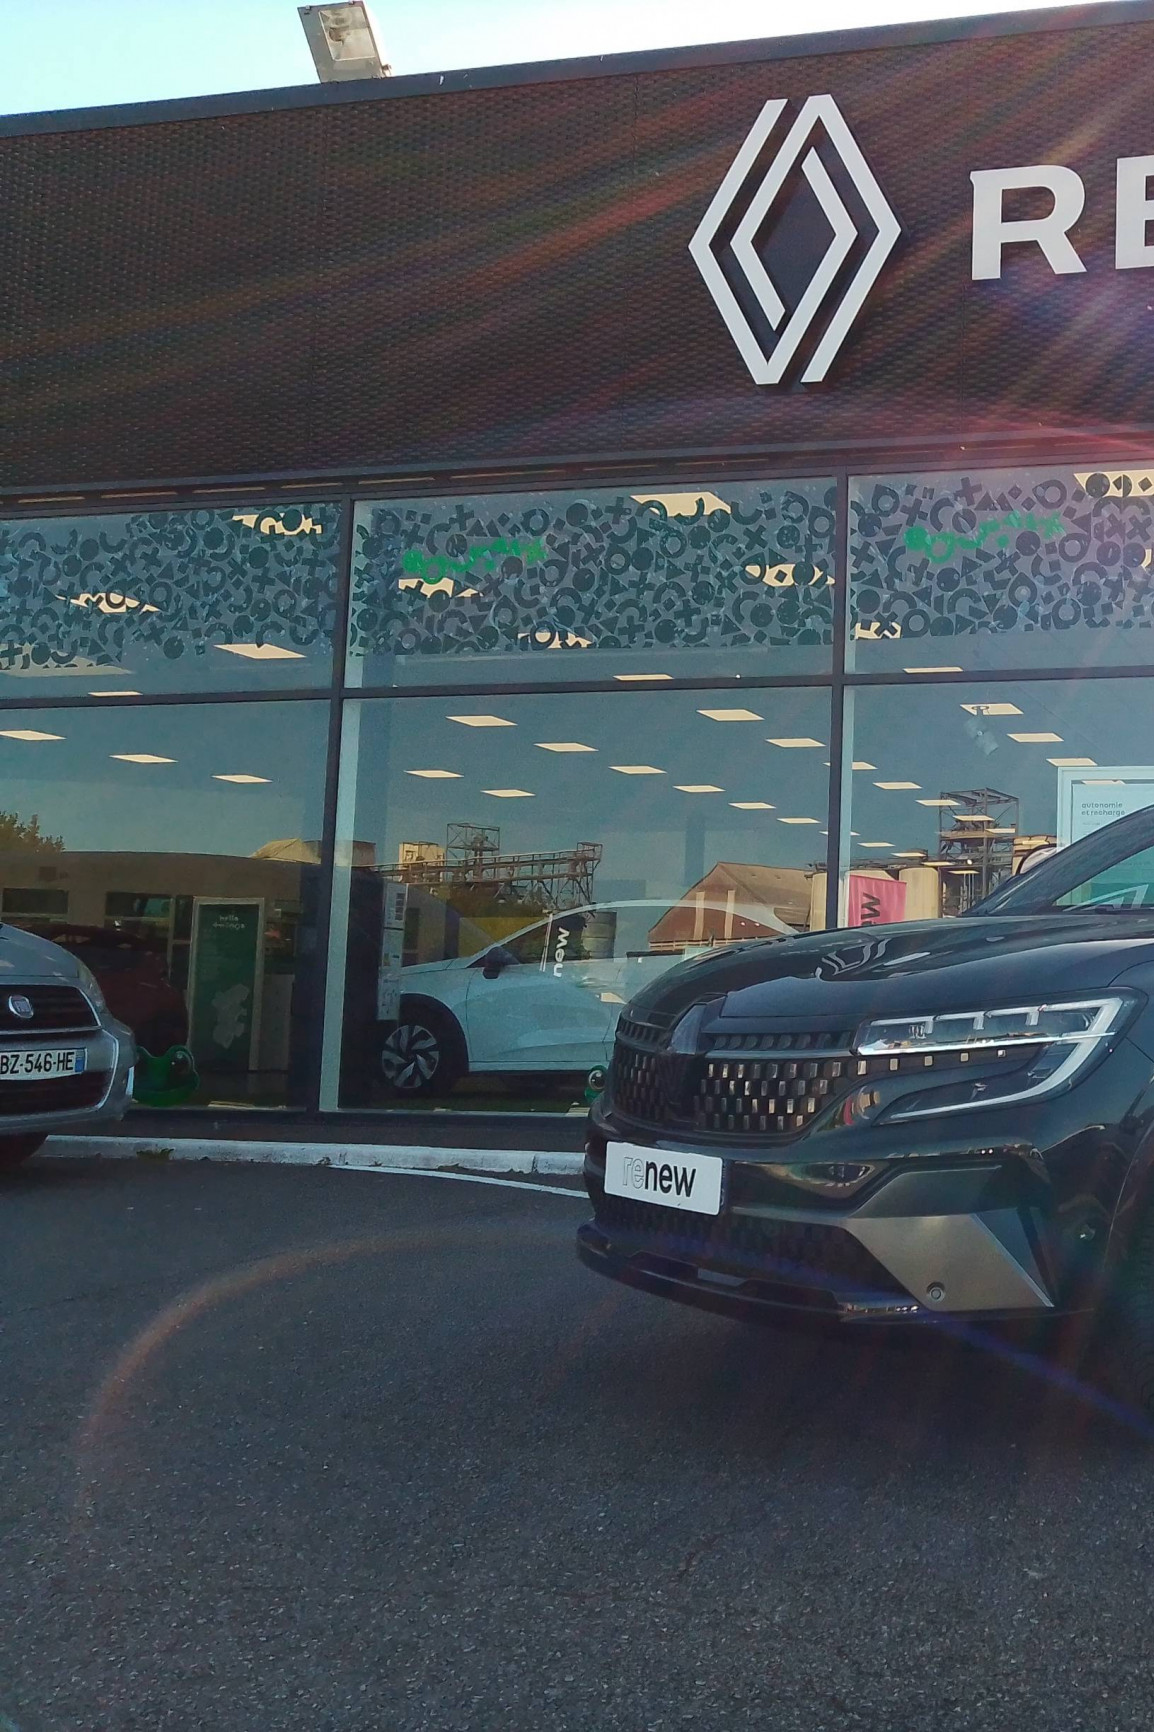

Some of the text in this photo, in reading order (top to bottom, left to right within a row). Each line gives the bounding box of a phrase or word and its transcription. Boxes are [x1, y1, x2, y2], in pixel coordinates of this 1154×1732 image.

[553, 926, 570, 978] new
[0, 1051, 75, 1075] BZ-546-HE
[622, 1156, 697, 1198] renew
